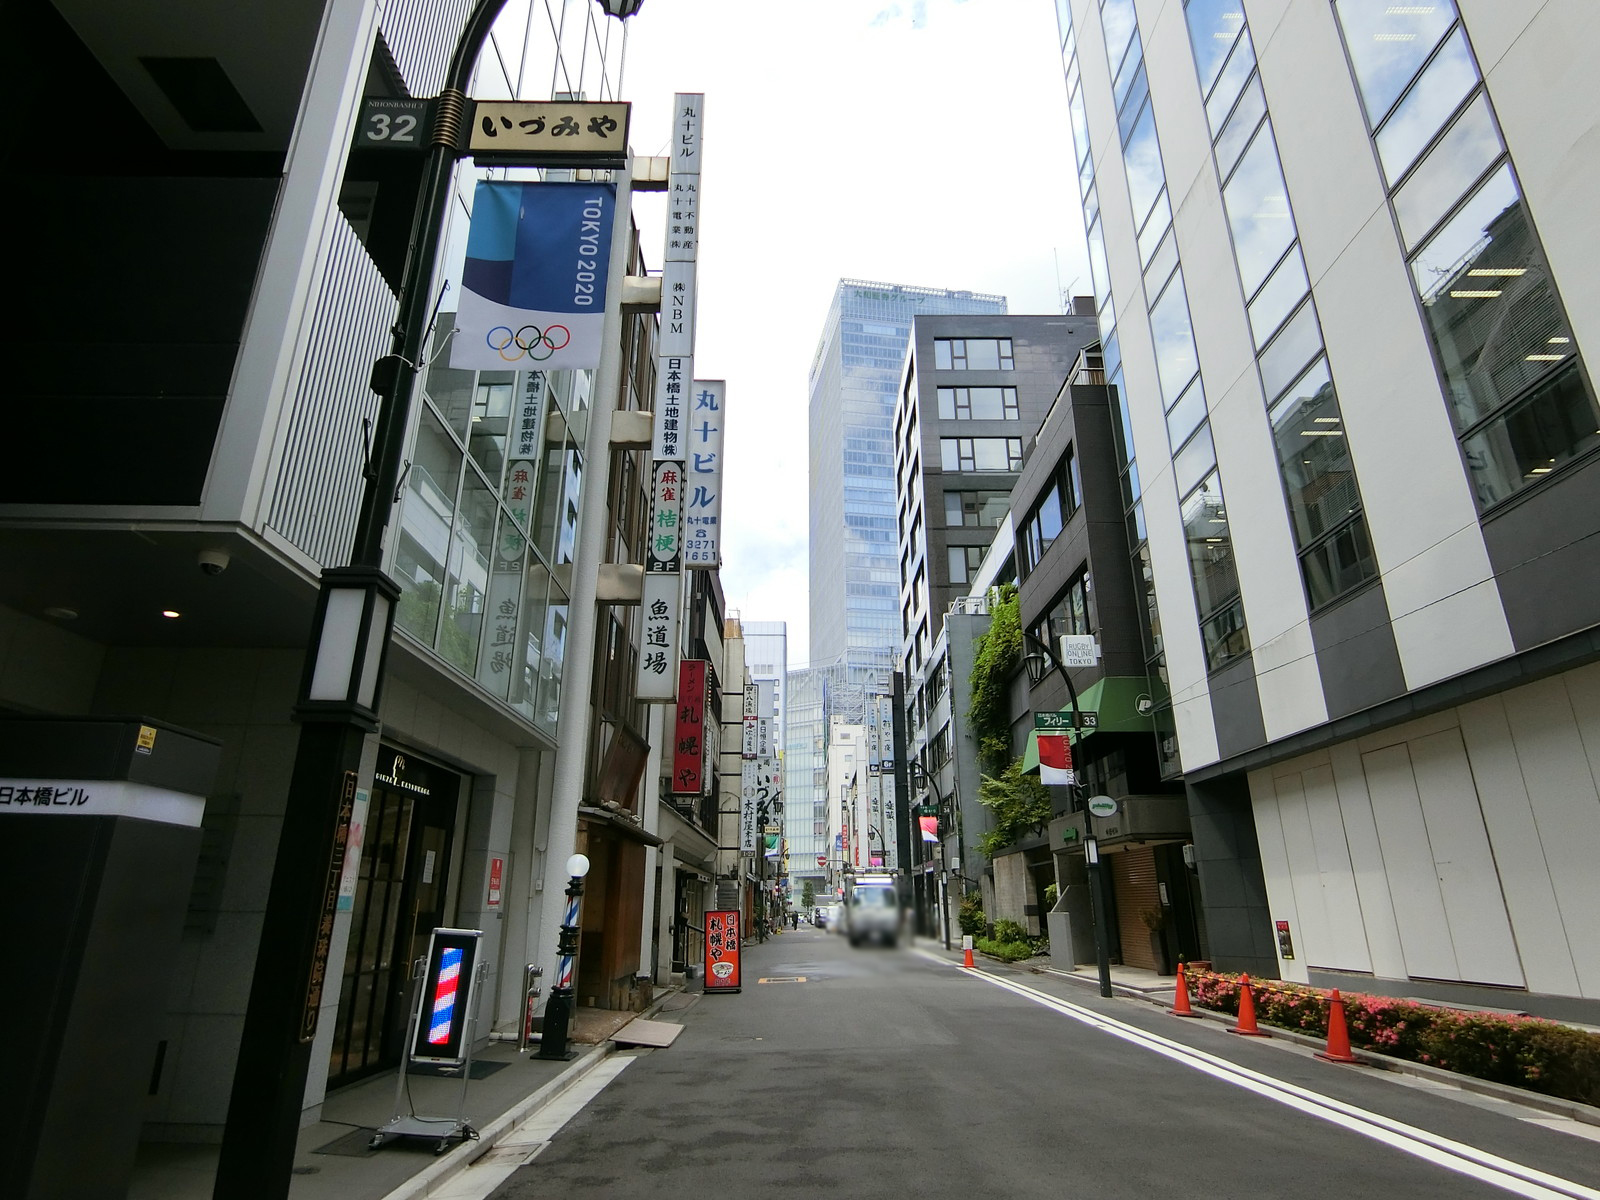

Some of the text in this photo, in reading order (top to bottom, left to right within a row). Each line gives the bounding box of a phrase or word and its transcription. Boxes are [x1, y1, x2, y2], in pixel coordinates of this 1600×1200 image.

[366, 113, 418, 142] 32
[481, 115, 618, 139] いづみや
[679, 107, 696, 157] 丸十ビル
[682, 184, 697, 250] 丸十不動産
[573, 196, 603, 307] TOKYO 2020
[690, 390, 719, 510] 丸十ビル
[655, 470, 678, 553] 麻雀 桔梗
[687, 516, 718, 526] 丸十電業
[684, 551, 717, 561] 1651
[686, 540, 716, 549] 3271
[653, 562, 675, 571] 2F
[643, 598, 671, 676] 魚道場
[1067, 650, 1092, 658] ONLINE
[687, 664, 696, 693] ラーメン
[1043, 717, 1069, 726] フィリー
[1084, 717, 1096, 726] 33
[679, 706, 699, 788] 札幌や
[375, 772, 393, 784] GINZA
[743, 799, 755, 848] 木村屋本店
[709, 917, 723, 962] 札幌や
[725, 914, 737, 951] 日本橋
